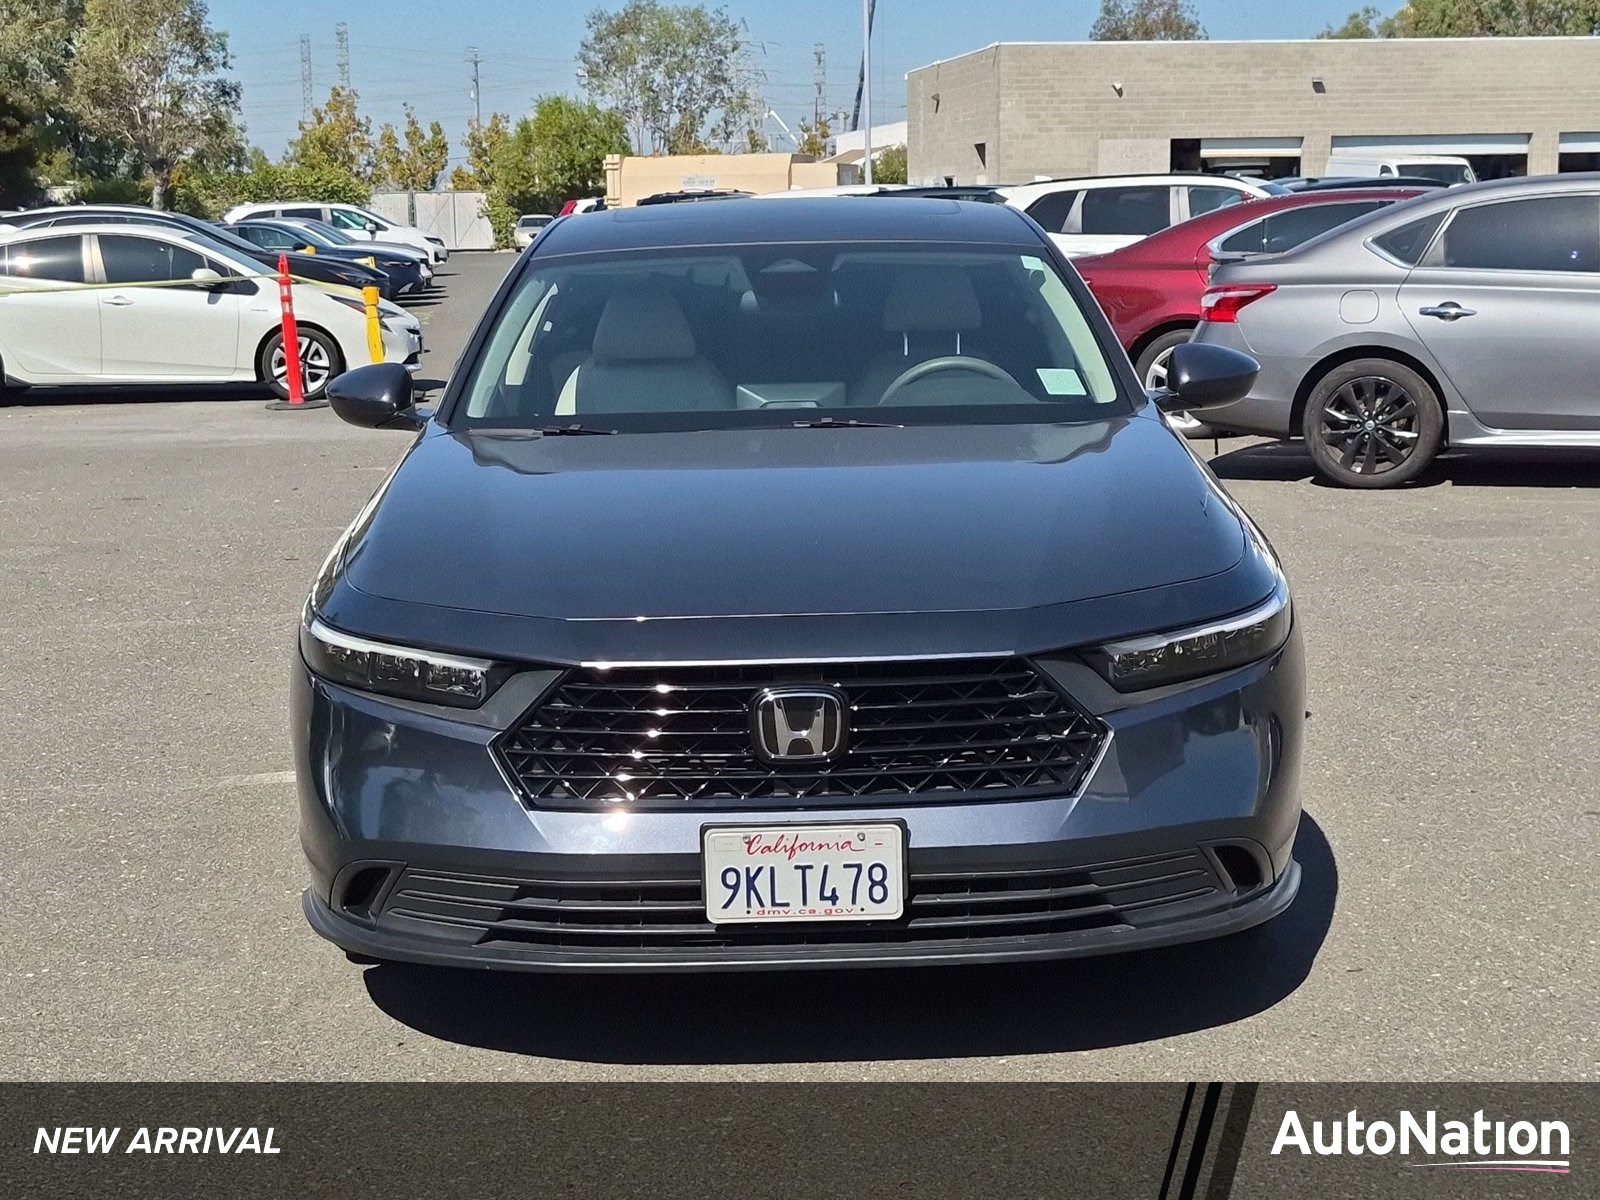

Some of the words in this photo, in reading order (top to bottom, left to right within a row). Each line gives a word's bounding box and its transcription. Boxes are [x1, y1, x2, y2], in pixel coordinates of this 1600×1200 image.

[746, 833, 866, 861] California
[720, 862, 888, 909] 9KLT478
[756, 907, 854, 917] dmv.ca.gov
